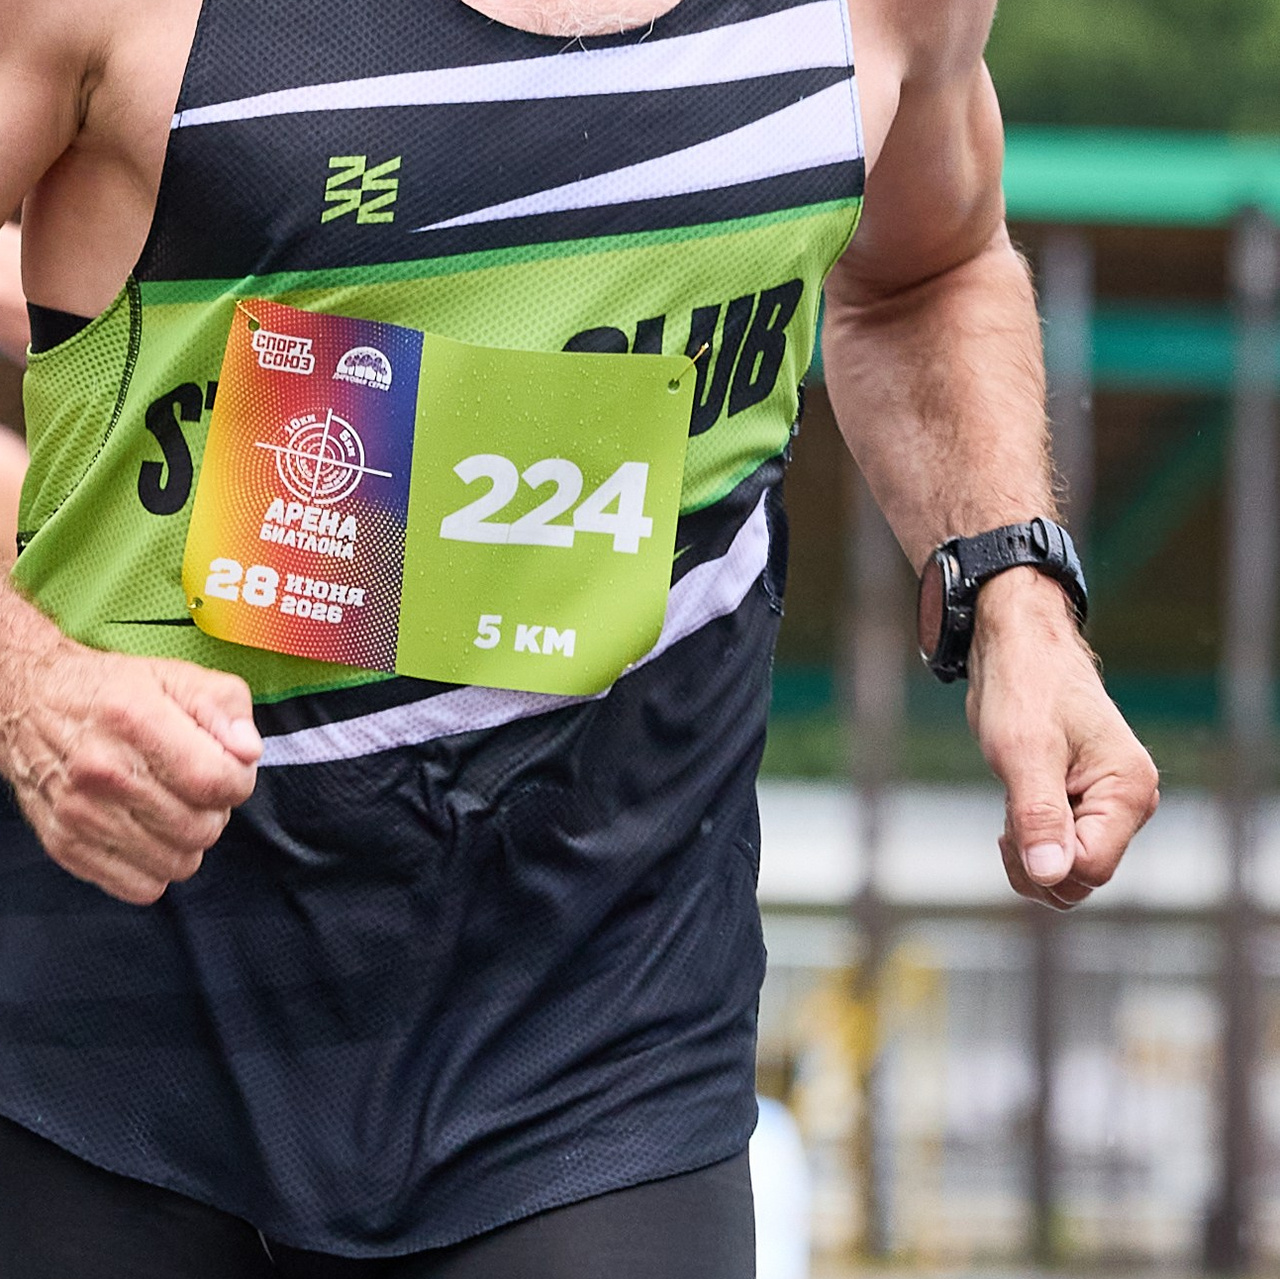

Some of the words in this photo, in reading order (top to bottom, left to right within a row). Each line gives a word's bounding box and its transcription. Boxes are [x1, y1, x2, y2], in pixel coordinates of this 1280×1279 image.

[262, 351, 312, 371] СОЮЗ
[561, 278, 804, 438] UB
[264, 497, 357, 541] АРЕНА
[439, 453, 653, 554] 224
[259, 523, 355, 560] БИАТЛОНА
[204, 557, 280, 608] 28
[279, 595, 343, 624] 2026
[473, 614, 503, 650] 5
